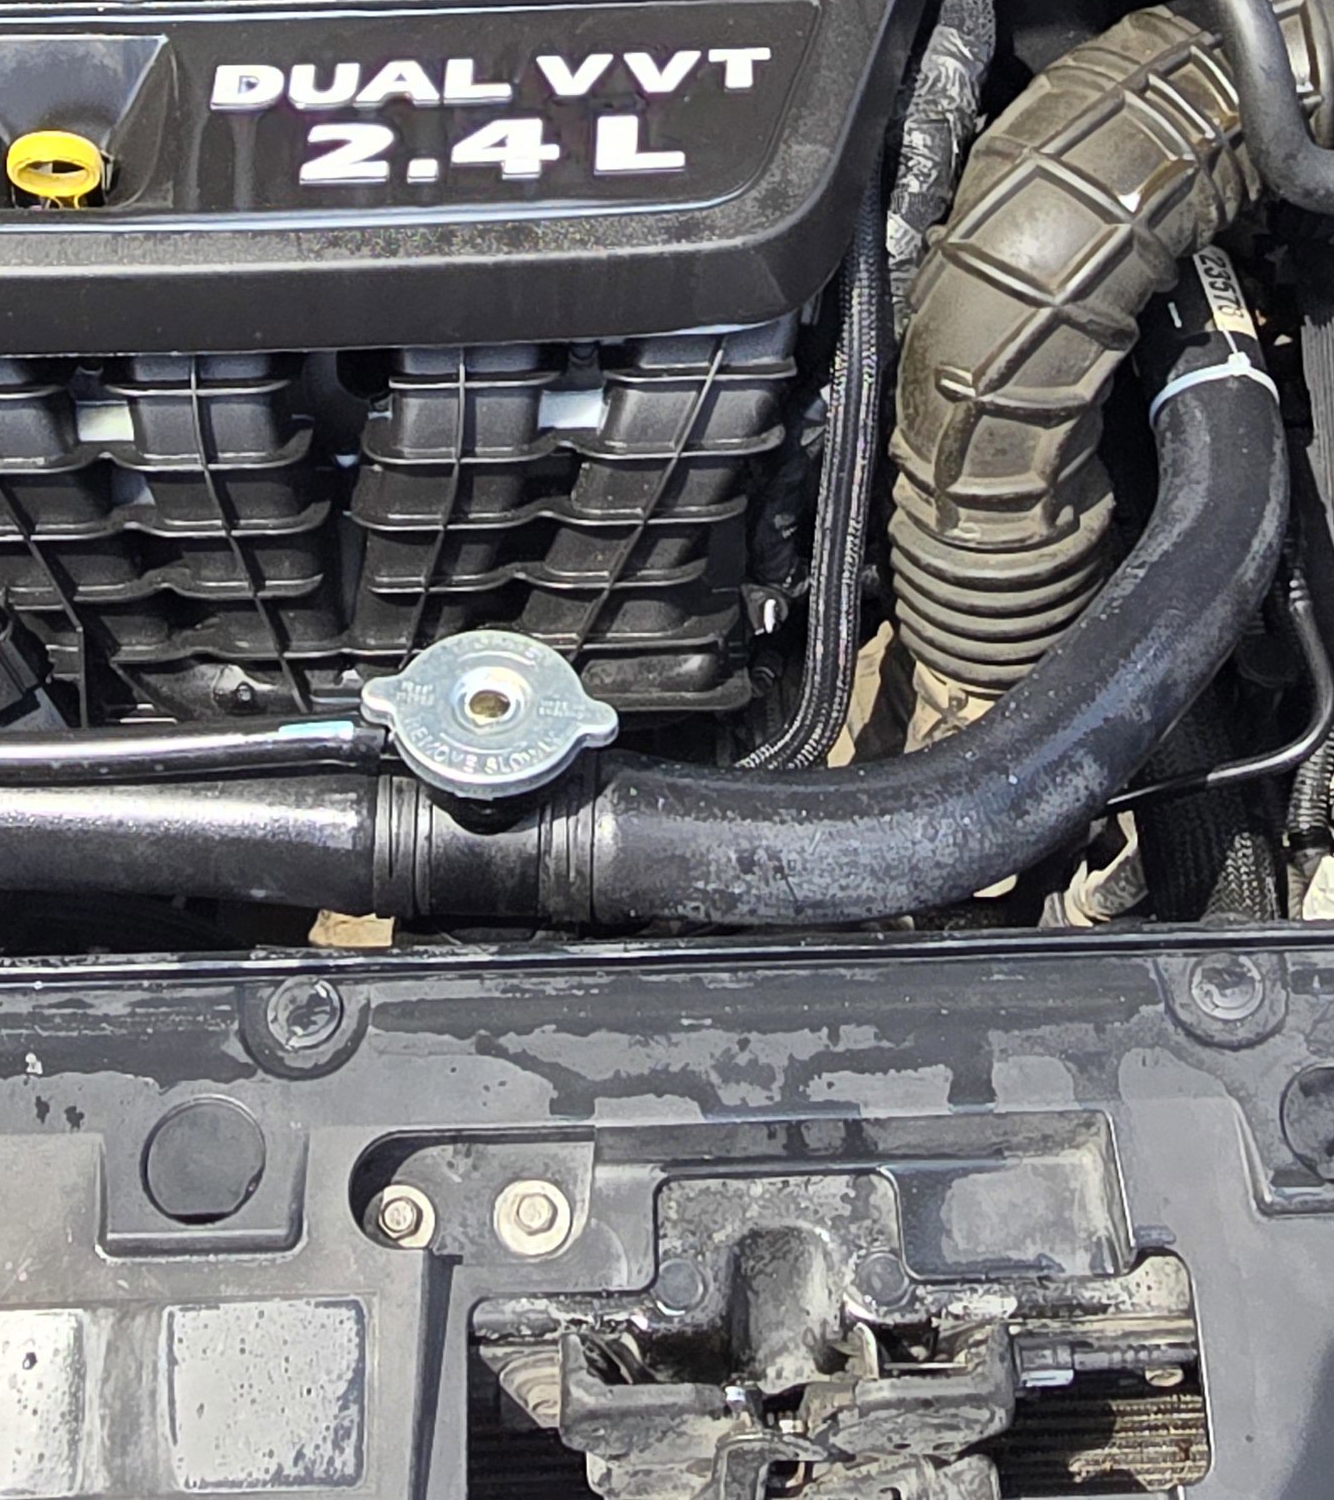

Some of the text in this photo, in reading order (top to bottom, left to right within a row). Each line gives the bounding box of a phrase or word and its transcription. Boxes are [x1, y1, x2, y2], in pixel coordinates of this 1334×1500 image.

[210, 47, 772, 111] DUAL VVT
[299, 114, 686, 185] 2.4 L
